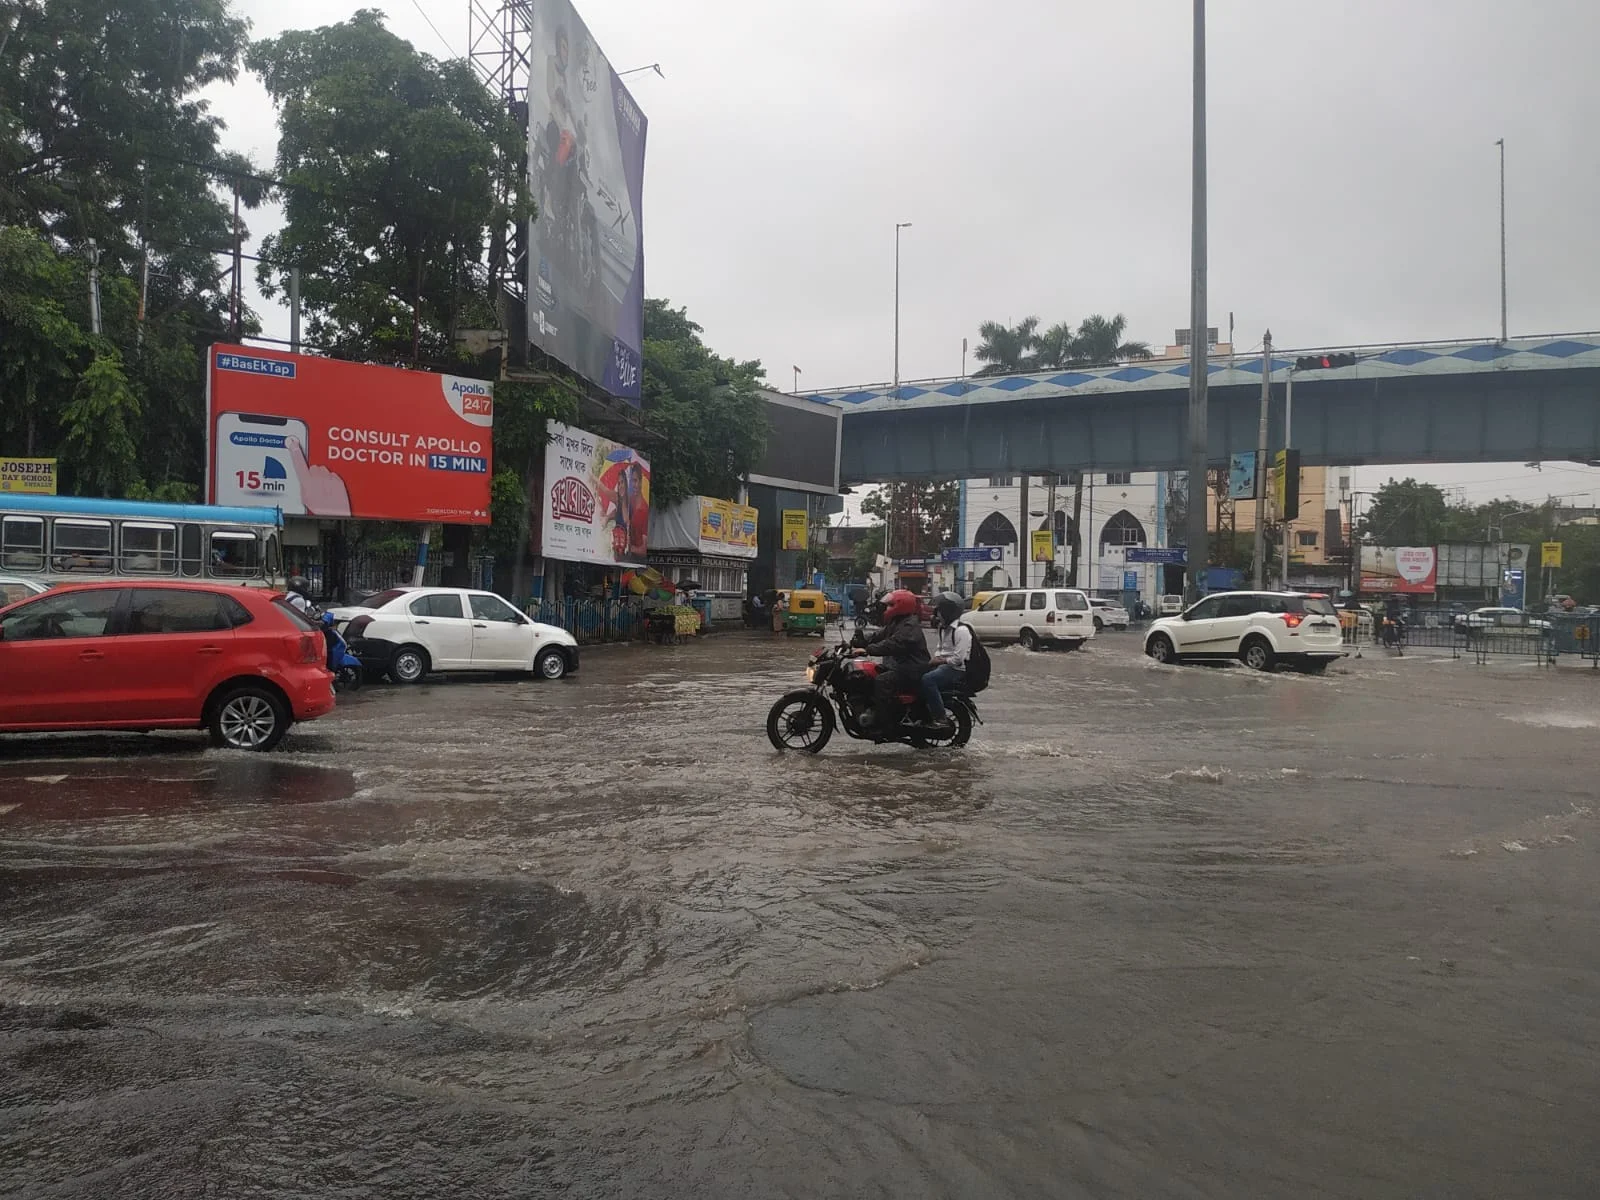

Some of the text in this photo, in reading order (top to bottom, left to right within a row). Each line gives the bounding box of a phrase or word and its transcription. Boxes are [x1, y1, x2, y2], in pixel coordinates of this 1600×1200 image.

[221, 356, 290, 376] #BasEkTap
[451, 381, 485, 396] Apollo
[233, 434, 258, 443] Apollo
[327, 426, 481, 454] CONSULT APOLLO
[1, 462, 52, 473] JOSEPH
[328, 445, 486, 472] DOCTOR IN 15 MIN.
[235, 470, 285, 491] 15 min
